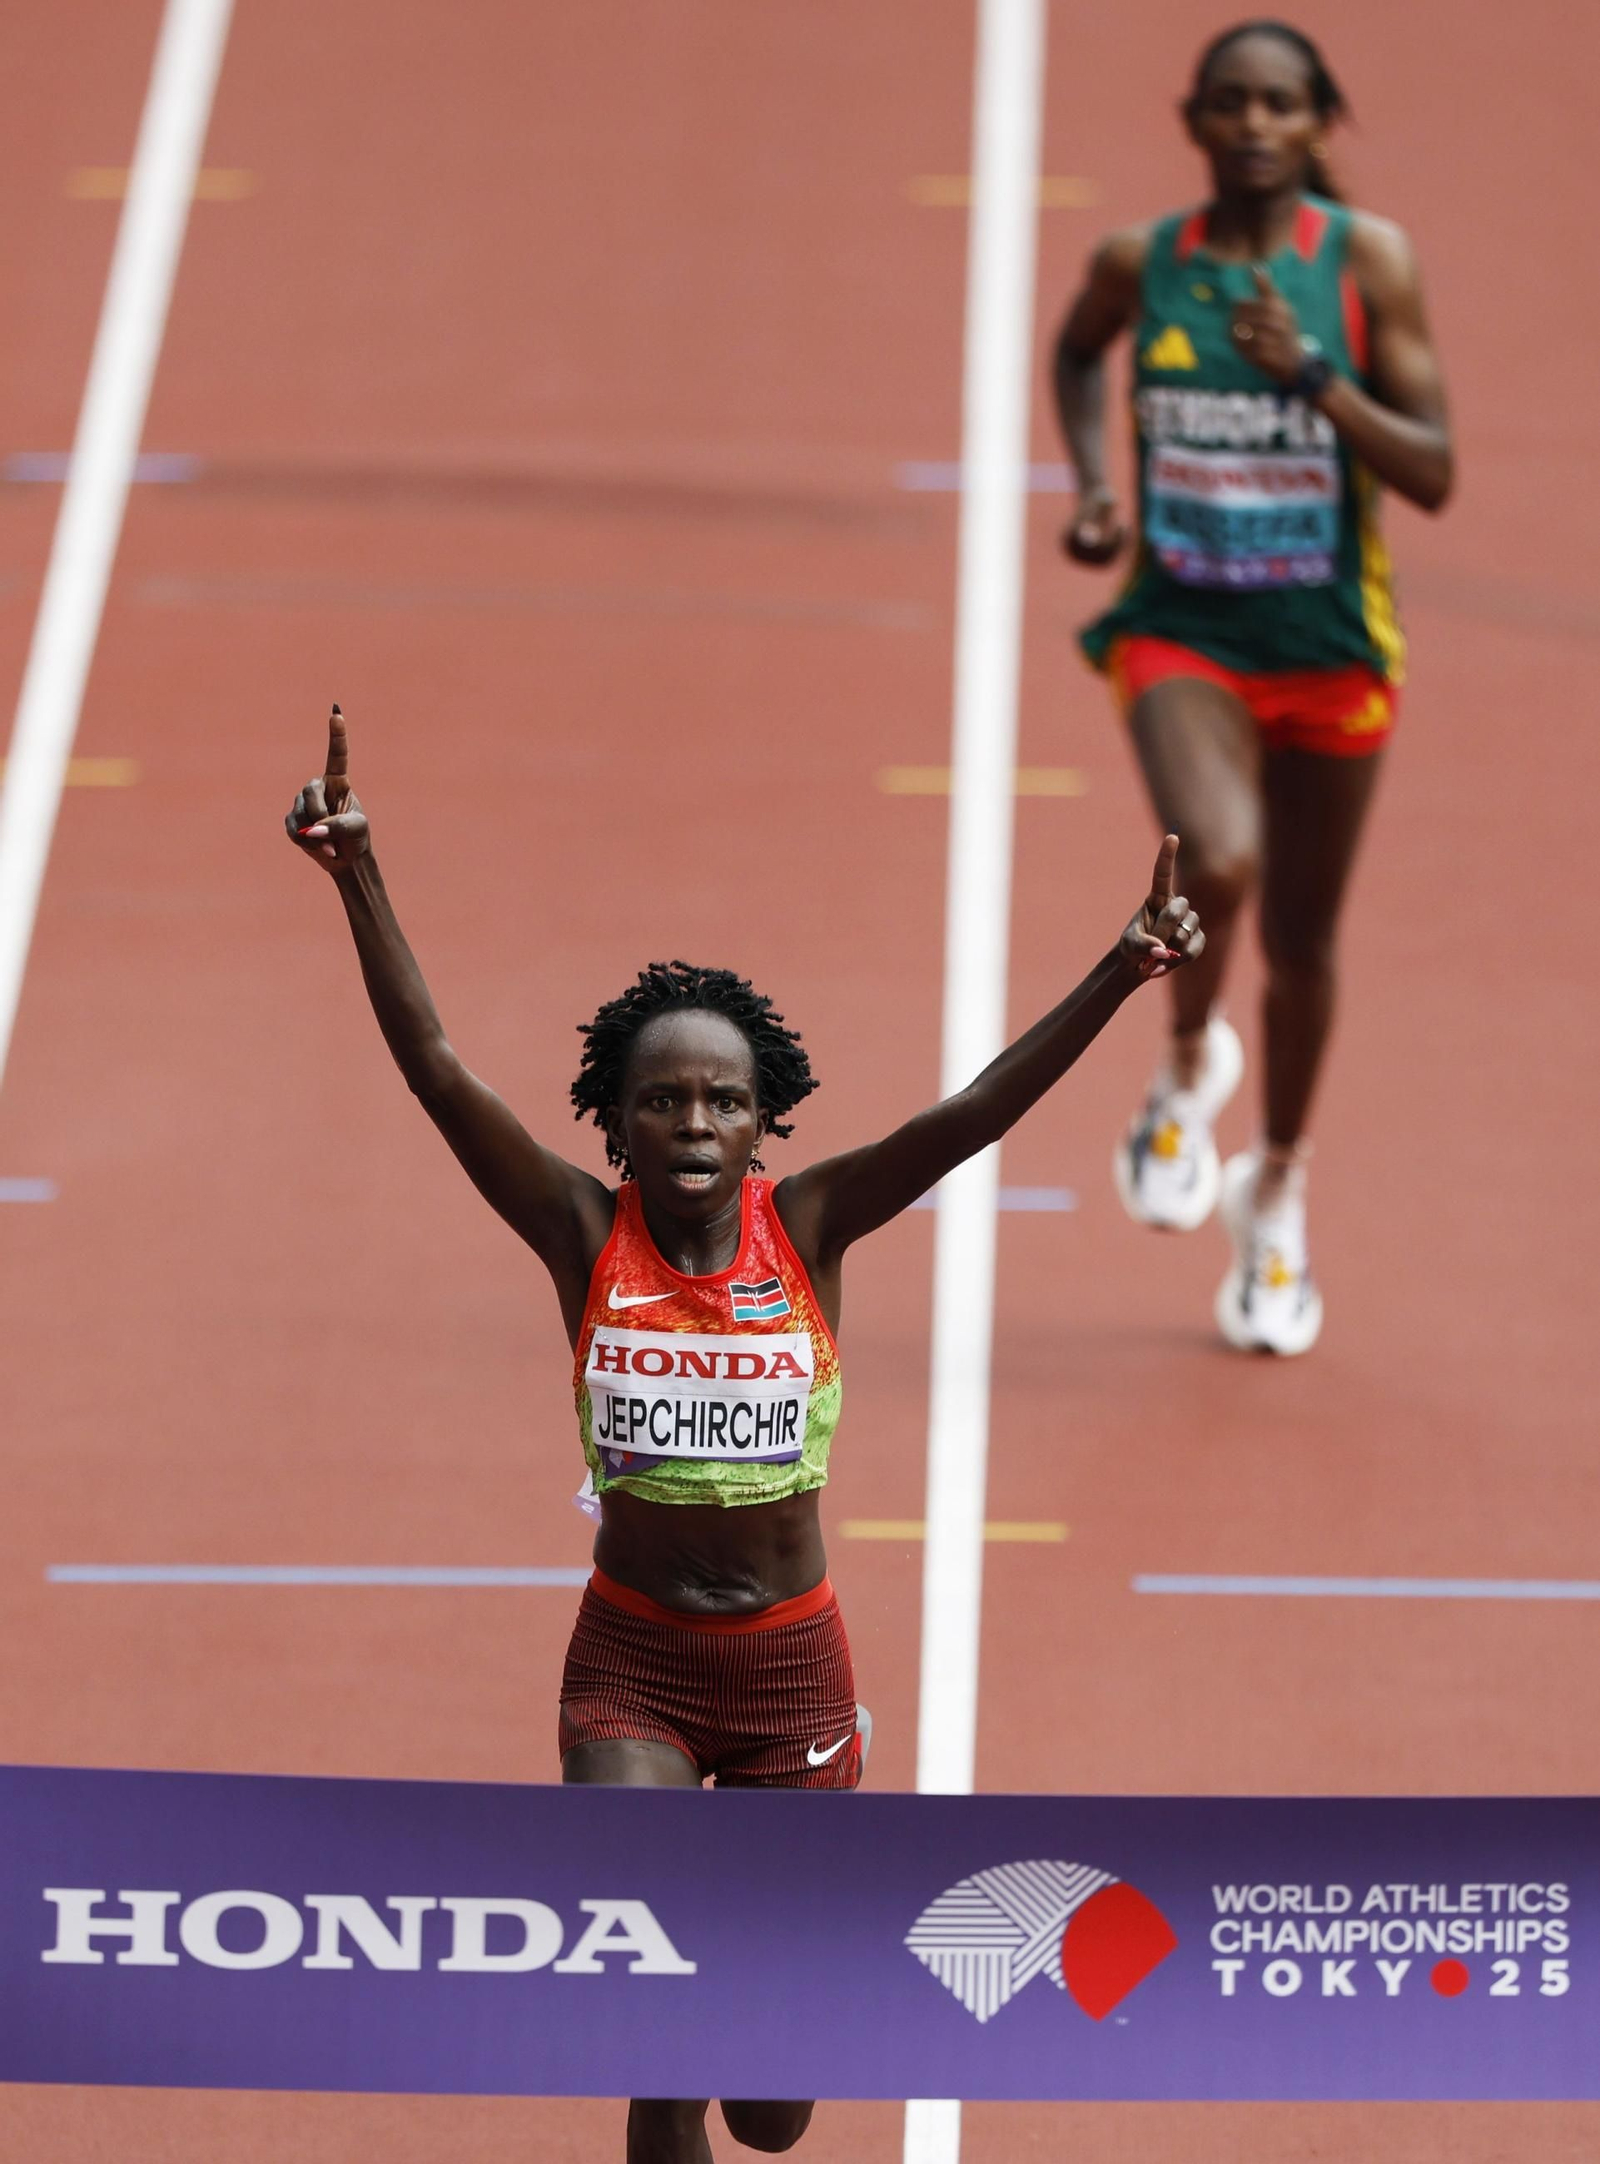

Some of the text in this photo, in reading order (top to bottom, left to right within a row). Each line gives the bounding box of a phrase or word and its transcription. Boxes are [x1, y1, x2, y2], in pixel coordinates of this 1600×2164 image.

[591, 1342, 809, 1381] HONDA
[597, 1393, 799, 1449] JEPCHIRCHIR
[1211, 1882, 1571, 1915] WORLD ATHLETICS
[41, 1887, 697, 1975] HONDA
[1209, 1918, 1571, 1955] CHAMPIONSHIPS
